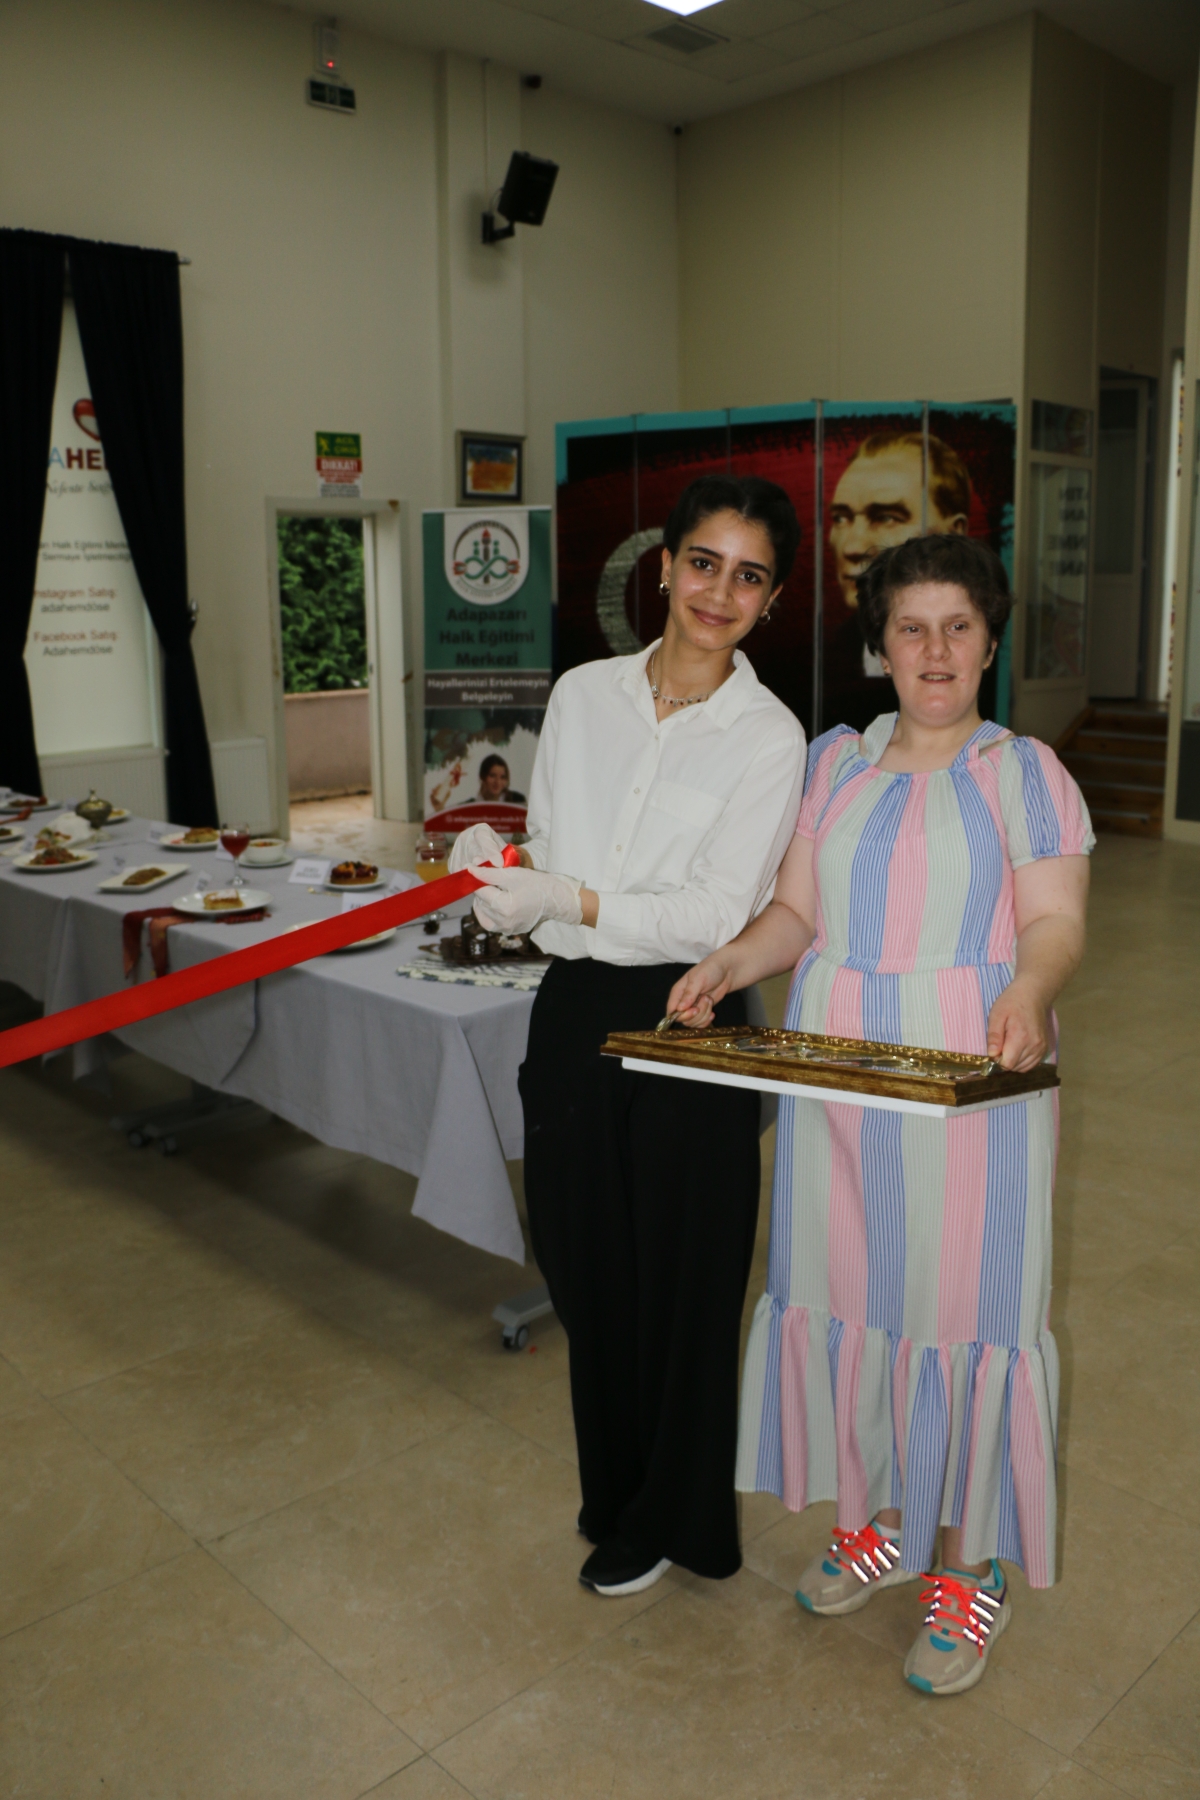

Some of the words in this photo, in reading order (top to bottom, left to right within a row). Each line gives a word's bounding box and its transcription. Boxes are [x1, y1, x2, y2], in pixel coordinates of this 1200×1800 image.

[48, 446, 106, 470] AHE
[34, 588, 84, 600] nstagram
[448, 607, 527, 625] Adapazarı
[440, 629, 475, 644] Halk
[479, 628, 535, 648] Eğitimi
[456, 651, 518, 666] Merkezi
[427, 678, 487, 690] Hayallerinizi
[490, 677, 549, 690] Ertelemeyin
[462, 691, 513, 703] Belgeleyin
